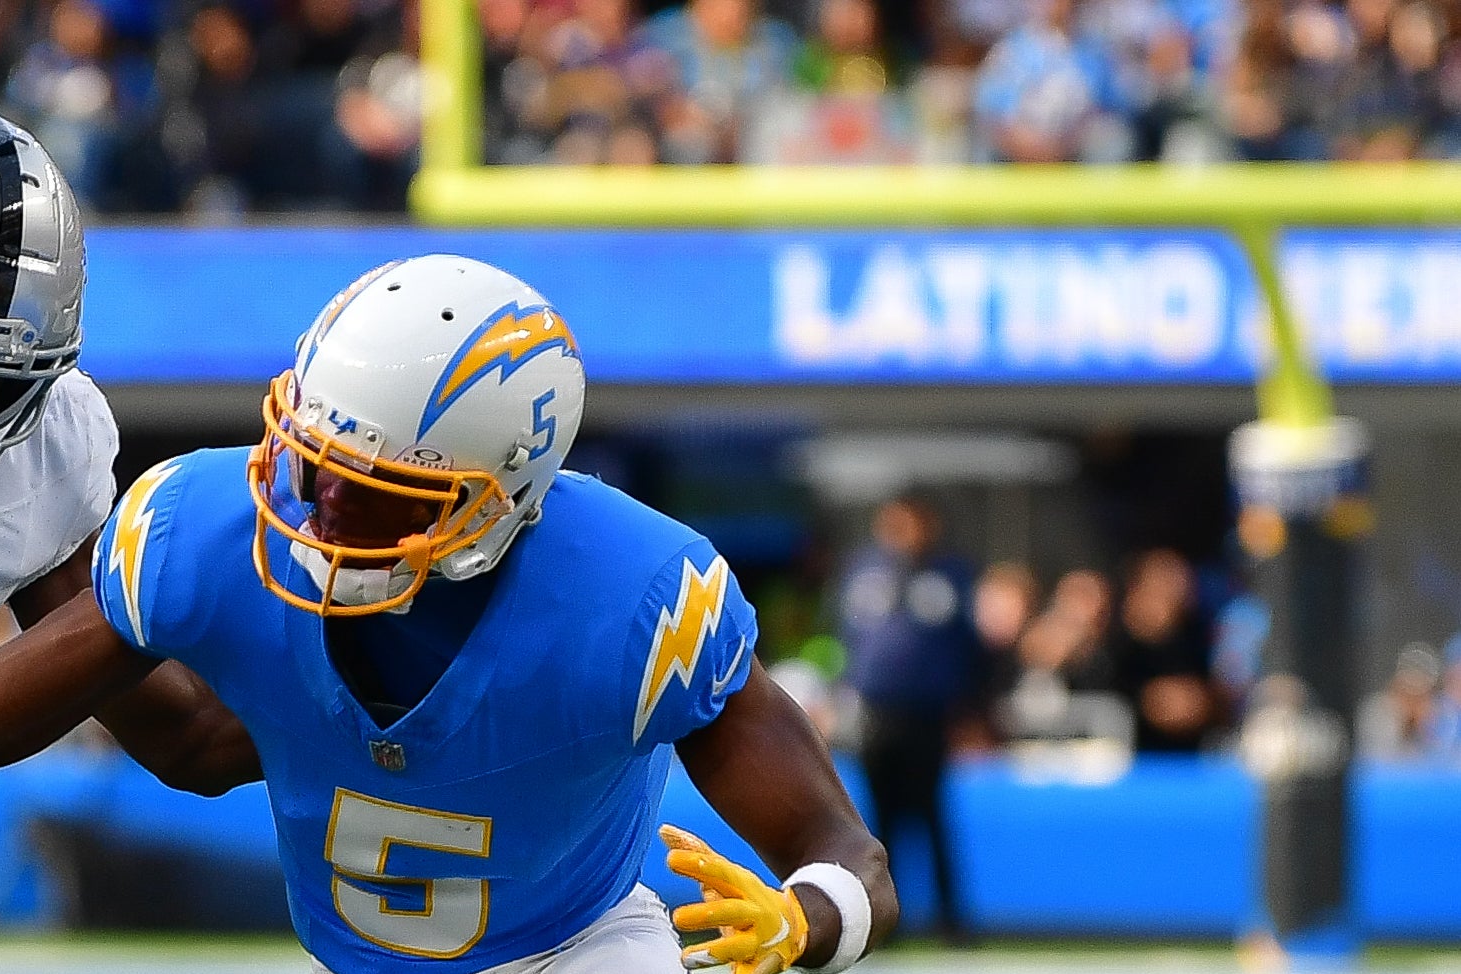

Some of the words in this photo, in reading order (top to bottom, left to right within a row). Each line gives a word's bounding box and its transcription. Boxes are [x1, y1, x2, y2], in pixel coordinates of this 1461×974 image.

[774, 242, 1226, 363] LATINO
[527, 386, 558, 462] 5
[323, 786, 493, 959] 5
